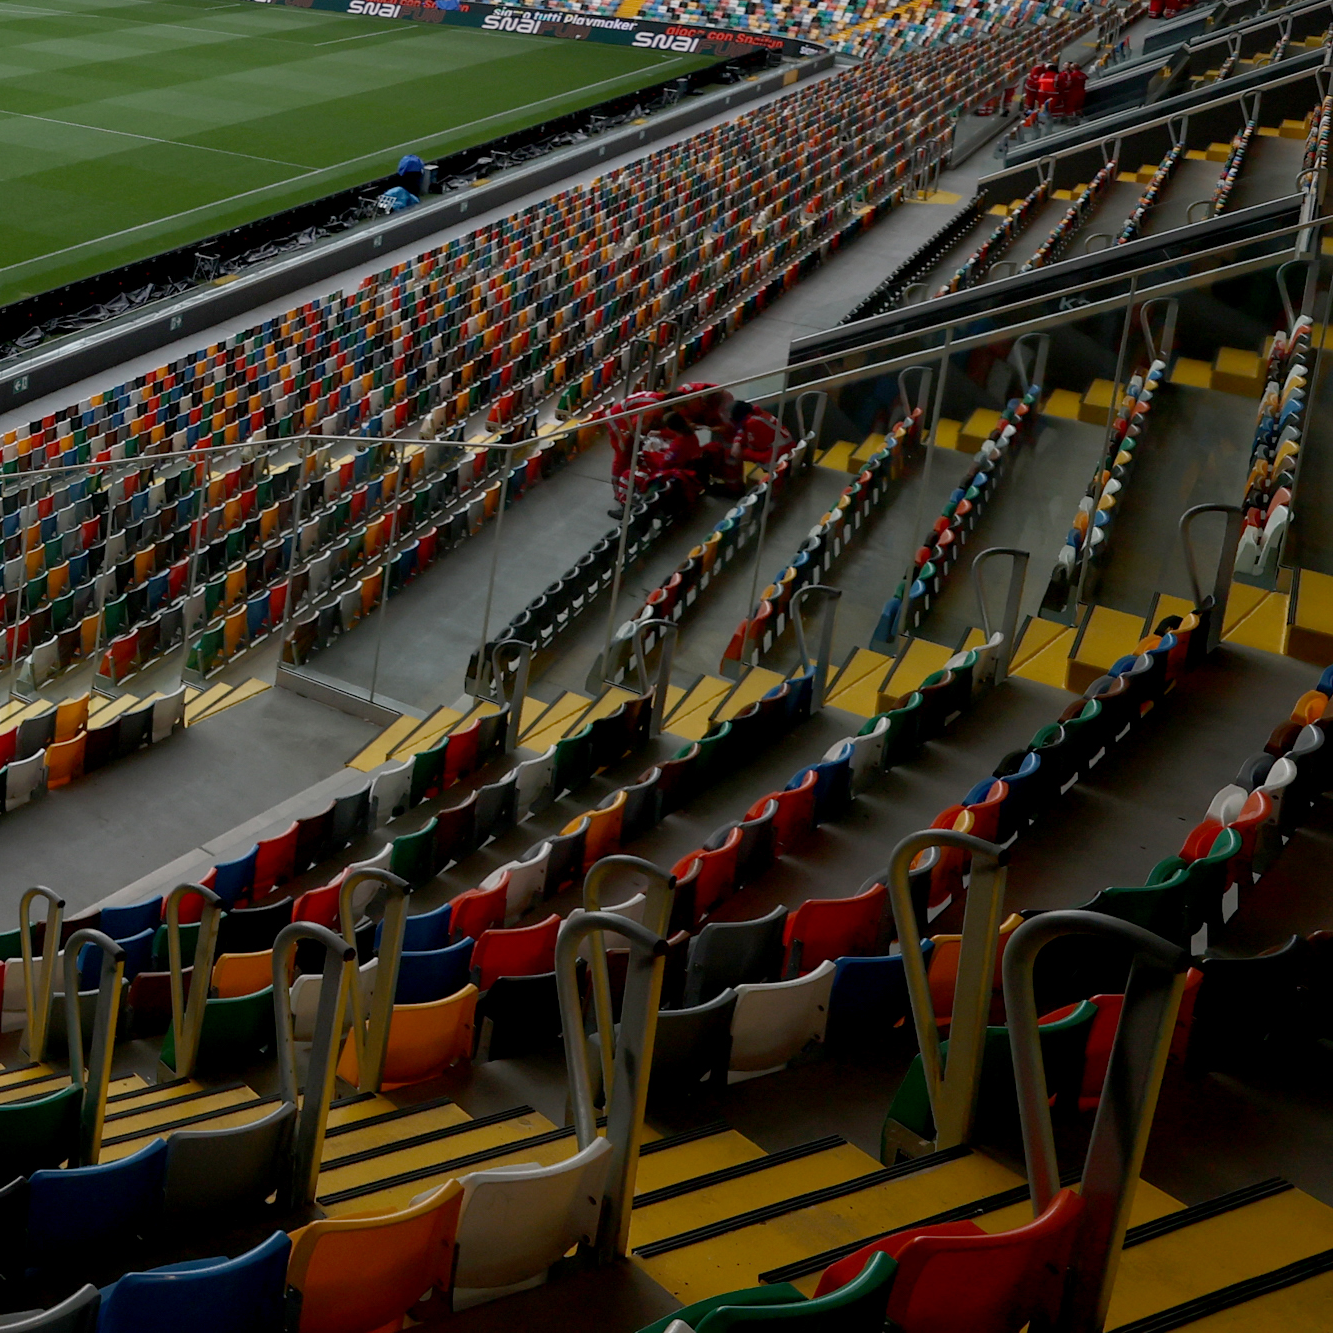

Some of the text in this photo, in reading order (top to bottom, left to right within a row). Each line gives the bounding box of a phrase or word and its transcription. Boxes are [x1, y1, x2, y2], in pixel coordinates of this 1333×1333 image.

[493, 6, 531, 19] siao
[533, 10, 563, 22] tutti
[707, 28, 732, 41] con
